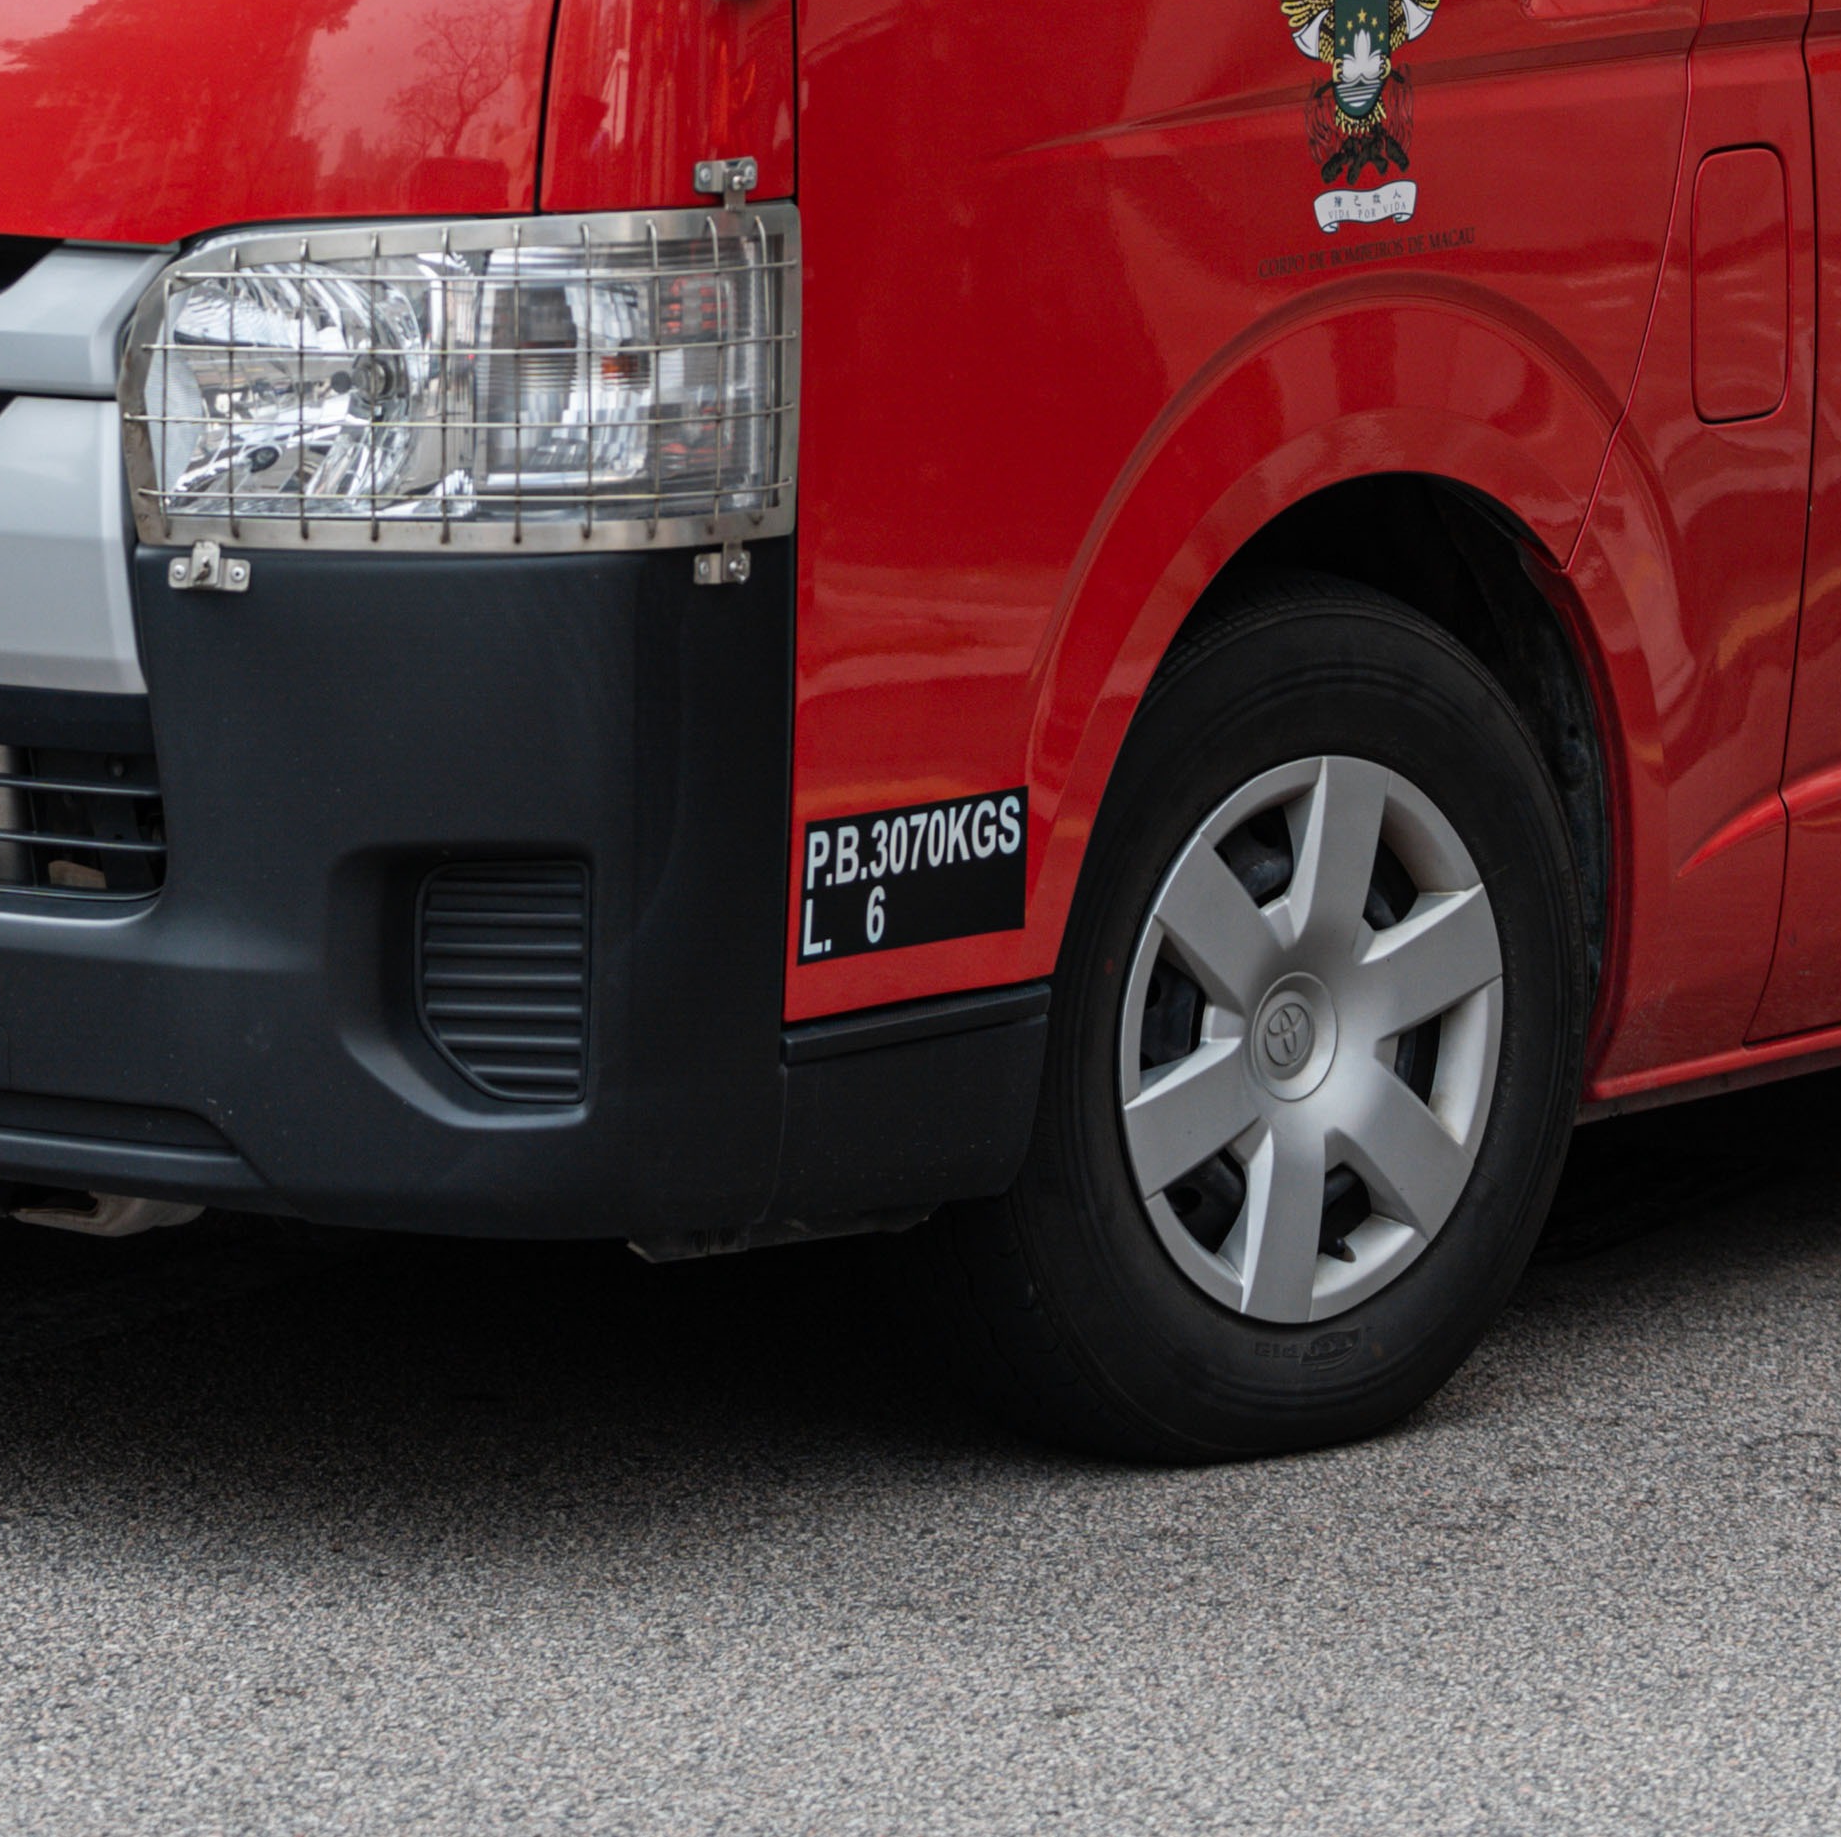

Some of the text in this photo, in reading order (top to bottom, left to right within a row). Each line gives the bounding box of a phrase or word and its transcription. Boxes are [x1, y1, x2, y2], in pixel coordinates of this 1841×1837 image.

[1383, 201, 1407, 213] VIDA
[1257, 226, 1476, 278] CORPO DE BOMBEIROS DE MACAU
[807, 794, 1021, 890] P.B.3070KGS
[803, 885, 886, 956] L. 6
